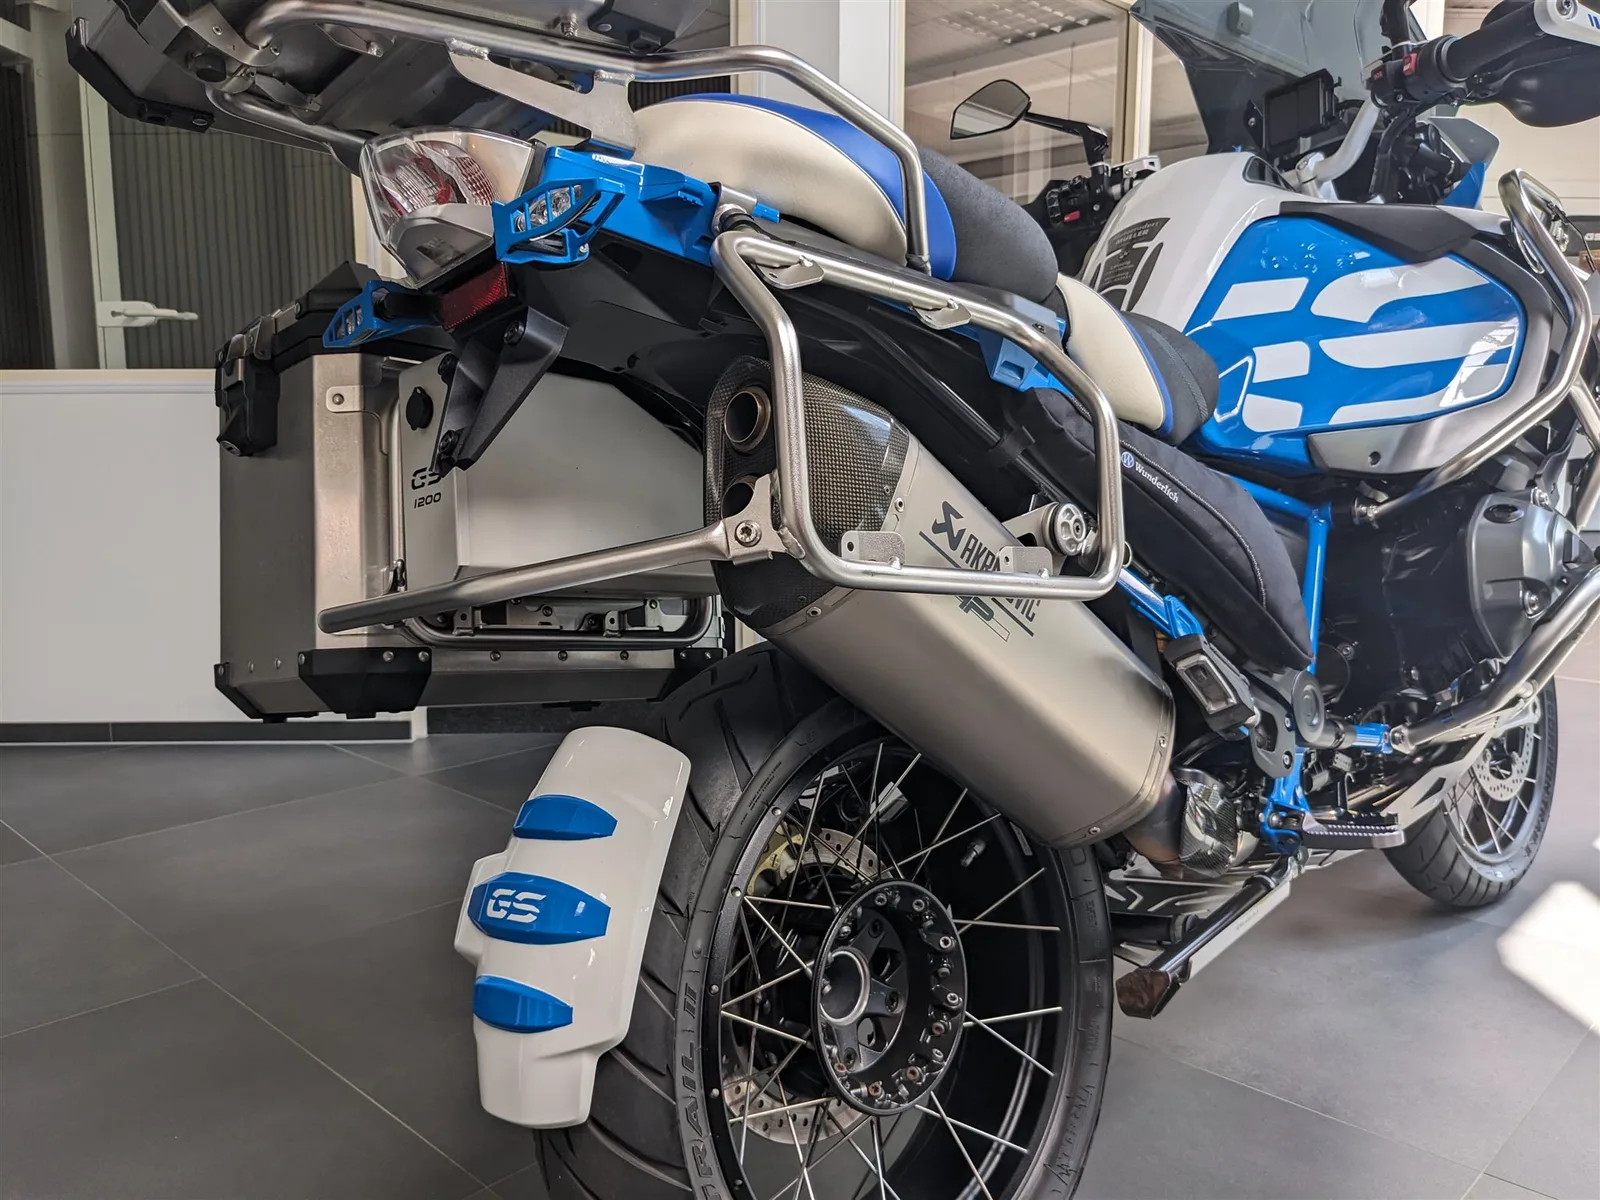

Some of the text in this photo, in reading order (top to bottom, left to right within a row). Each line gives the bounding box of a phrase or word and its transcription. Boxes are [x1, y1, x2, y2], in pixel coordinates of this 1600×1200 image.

[1135, 461, 1179, 503] Wunderlich
[414, 492, 441, 509] 1200
[486, 888, 547, 924] GS
